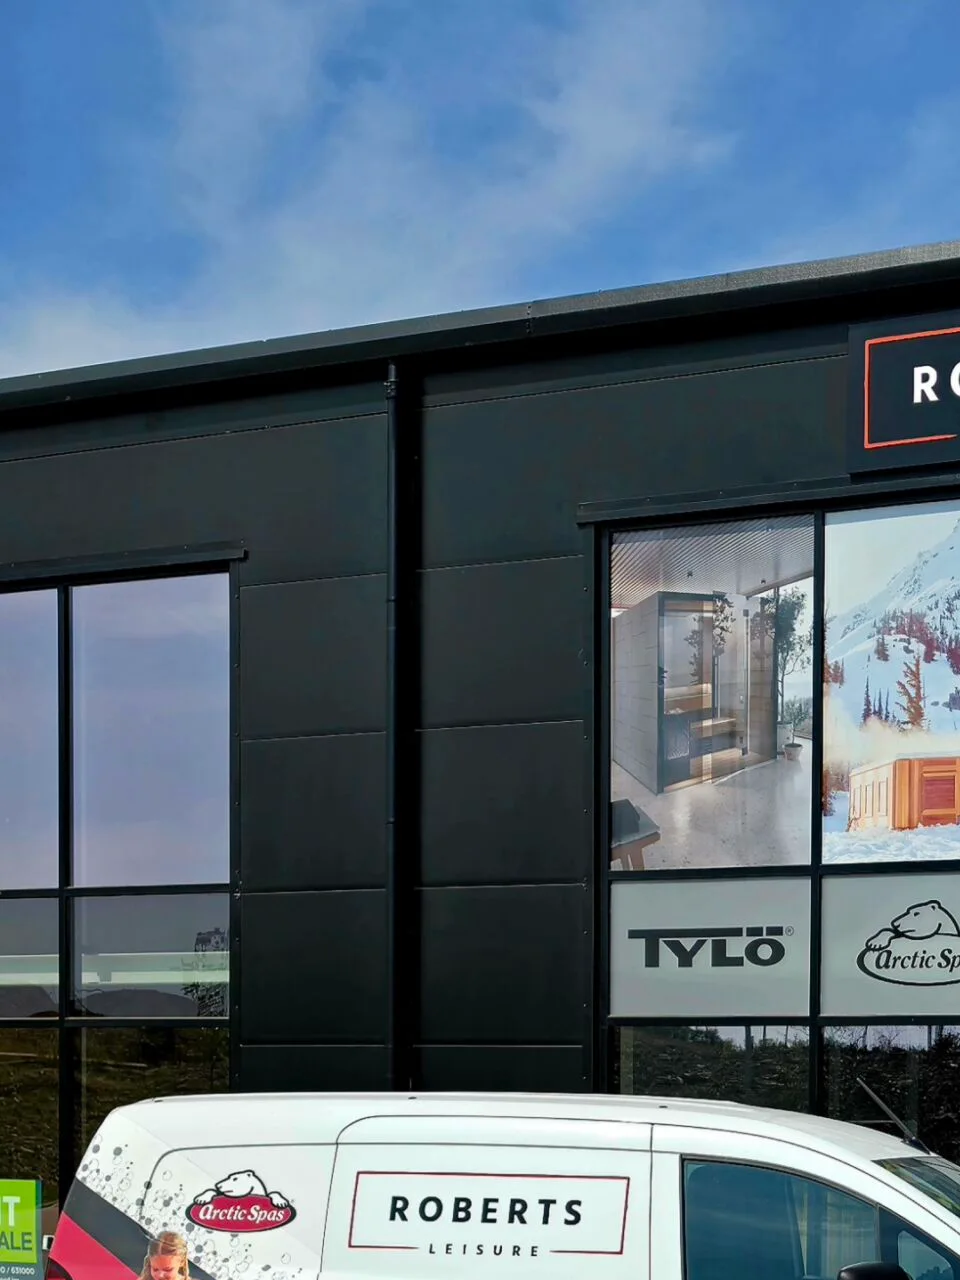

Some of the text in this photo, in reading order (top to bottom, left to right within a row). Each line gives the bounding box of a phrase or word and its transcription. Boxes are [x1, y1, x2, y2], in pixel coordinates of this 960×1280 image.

[247, 1204, 285, 1224] Spas
[388, 1195, 583, 1226] ROBERTS
[428, 1243, 540, 1257] LEISURE
